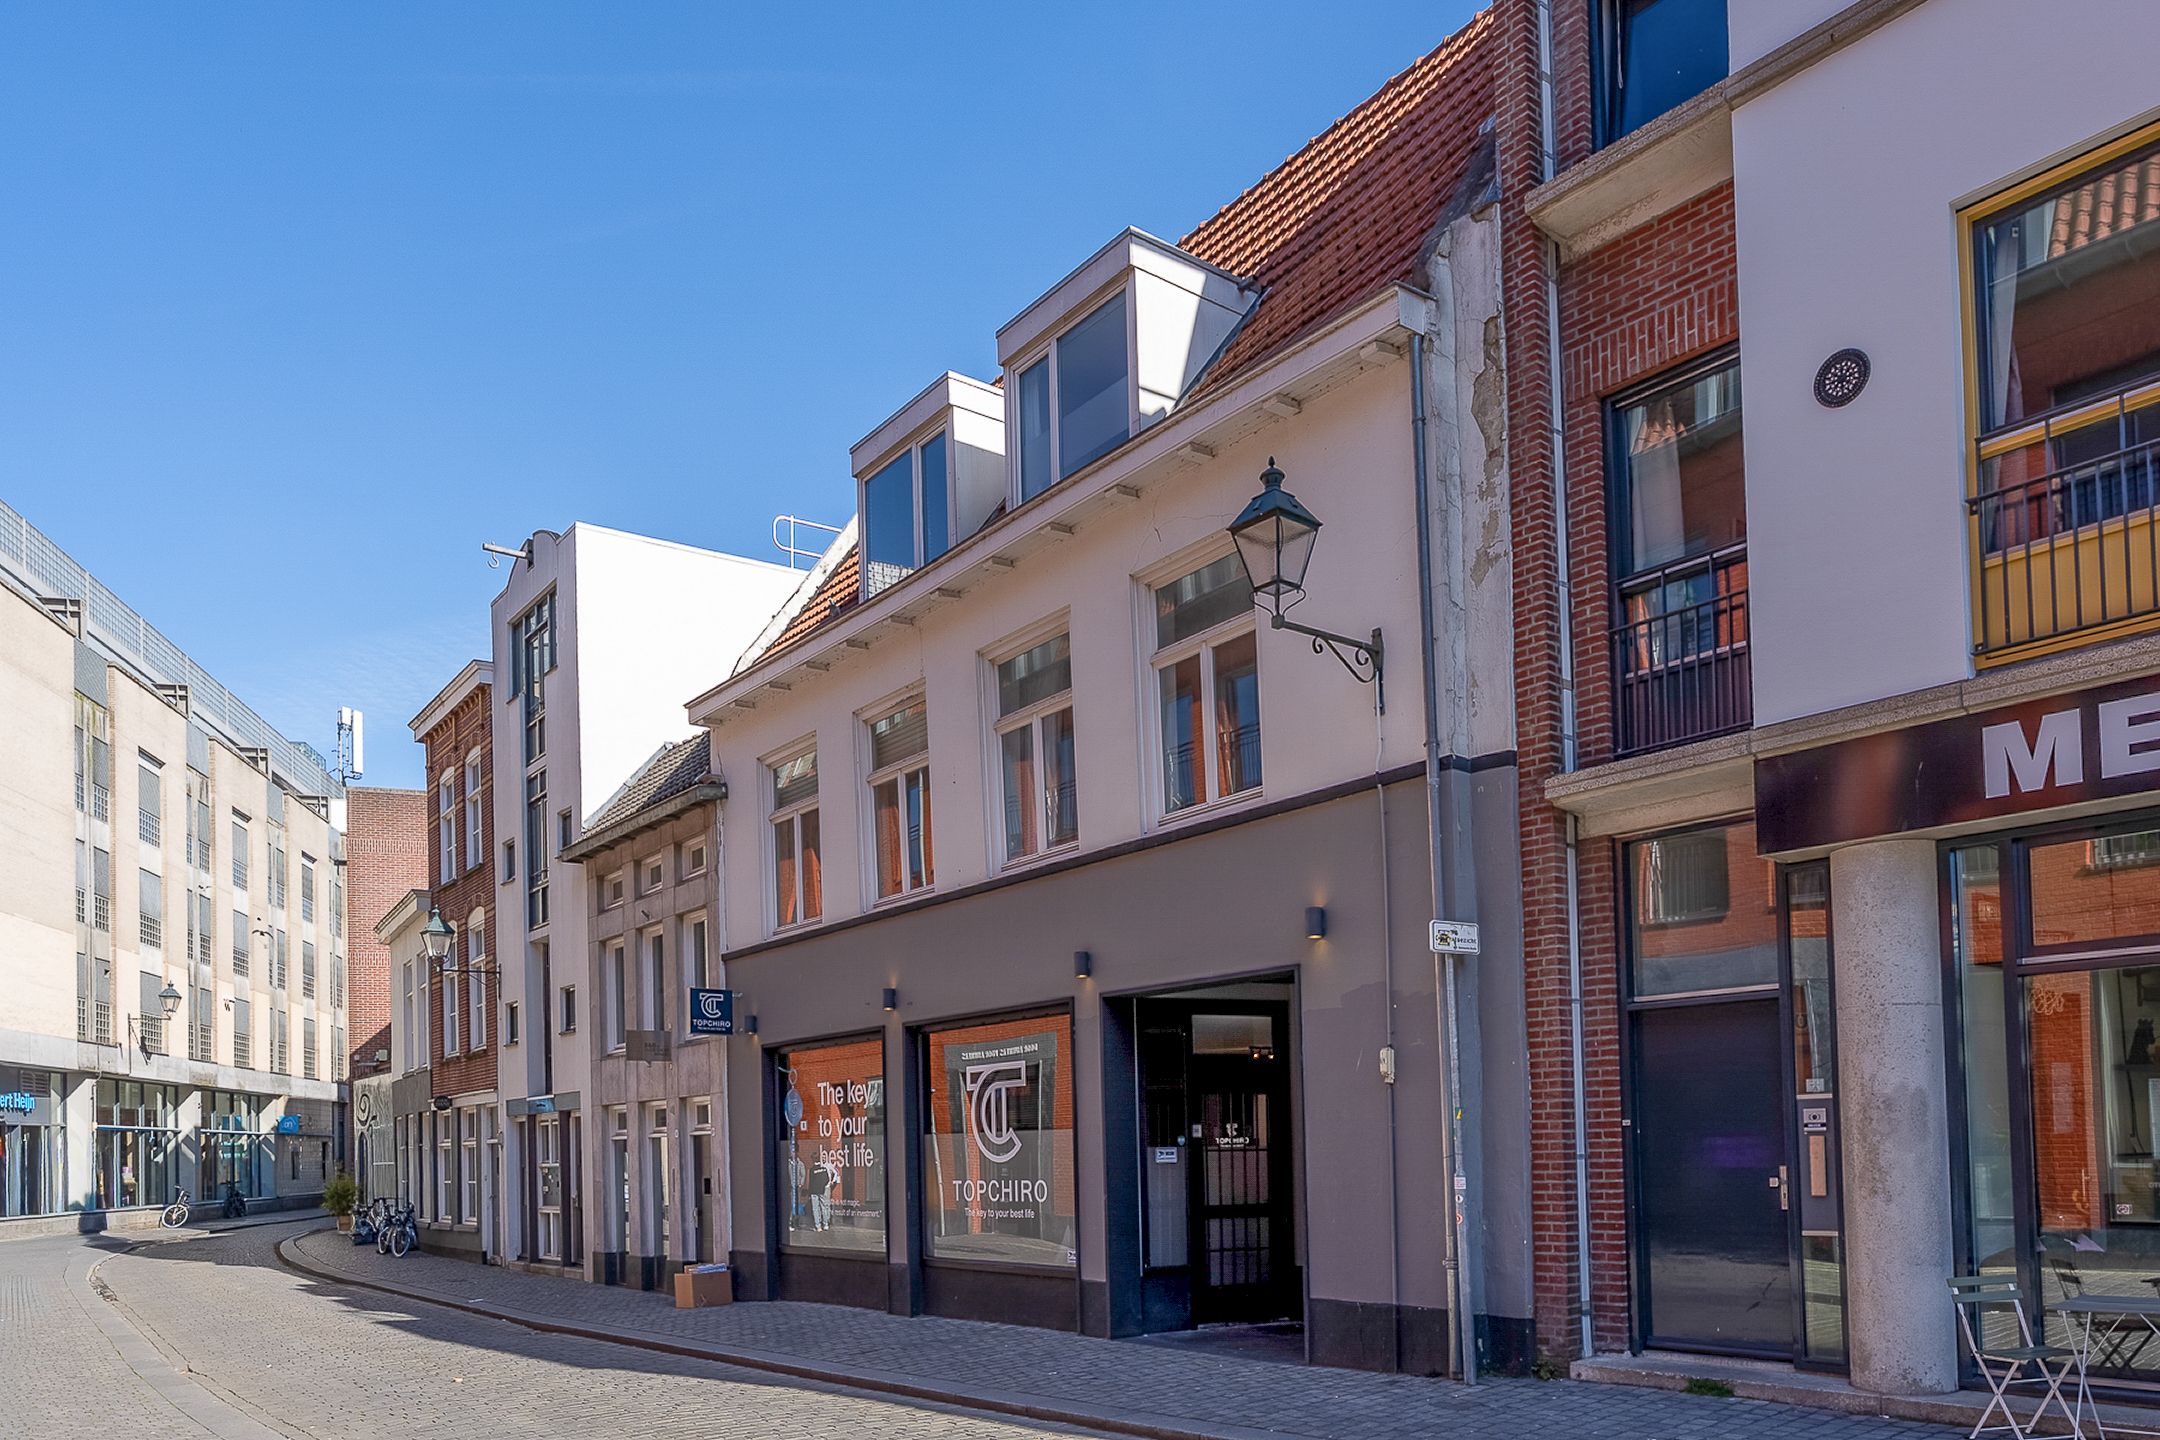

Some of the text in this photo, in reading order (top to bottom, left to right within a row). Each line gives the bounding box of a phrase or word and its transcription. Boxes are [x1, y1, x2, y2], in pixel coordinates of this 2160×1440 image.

[692, 1018, 731, 1028] TOPCHIRO
[13, 1092, 35, 1112] Heijn
[817, 1079, 871, 1109] The key
[818, 1115, 867, 1142] to your
[819, 1142, 874, 1168] best life
[952, 1179, 1048, 1203] TOPCHIRO
[965, 1207, 1035, 1220] The key to your best life
